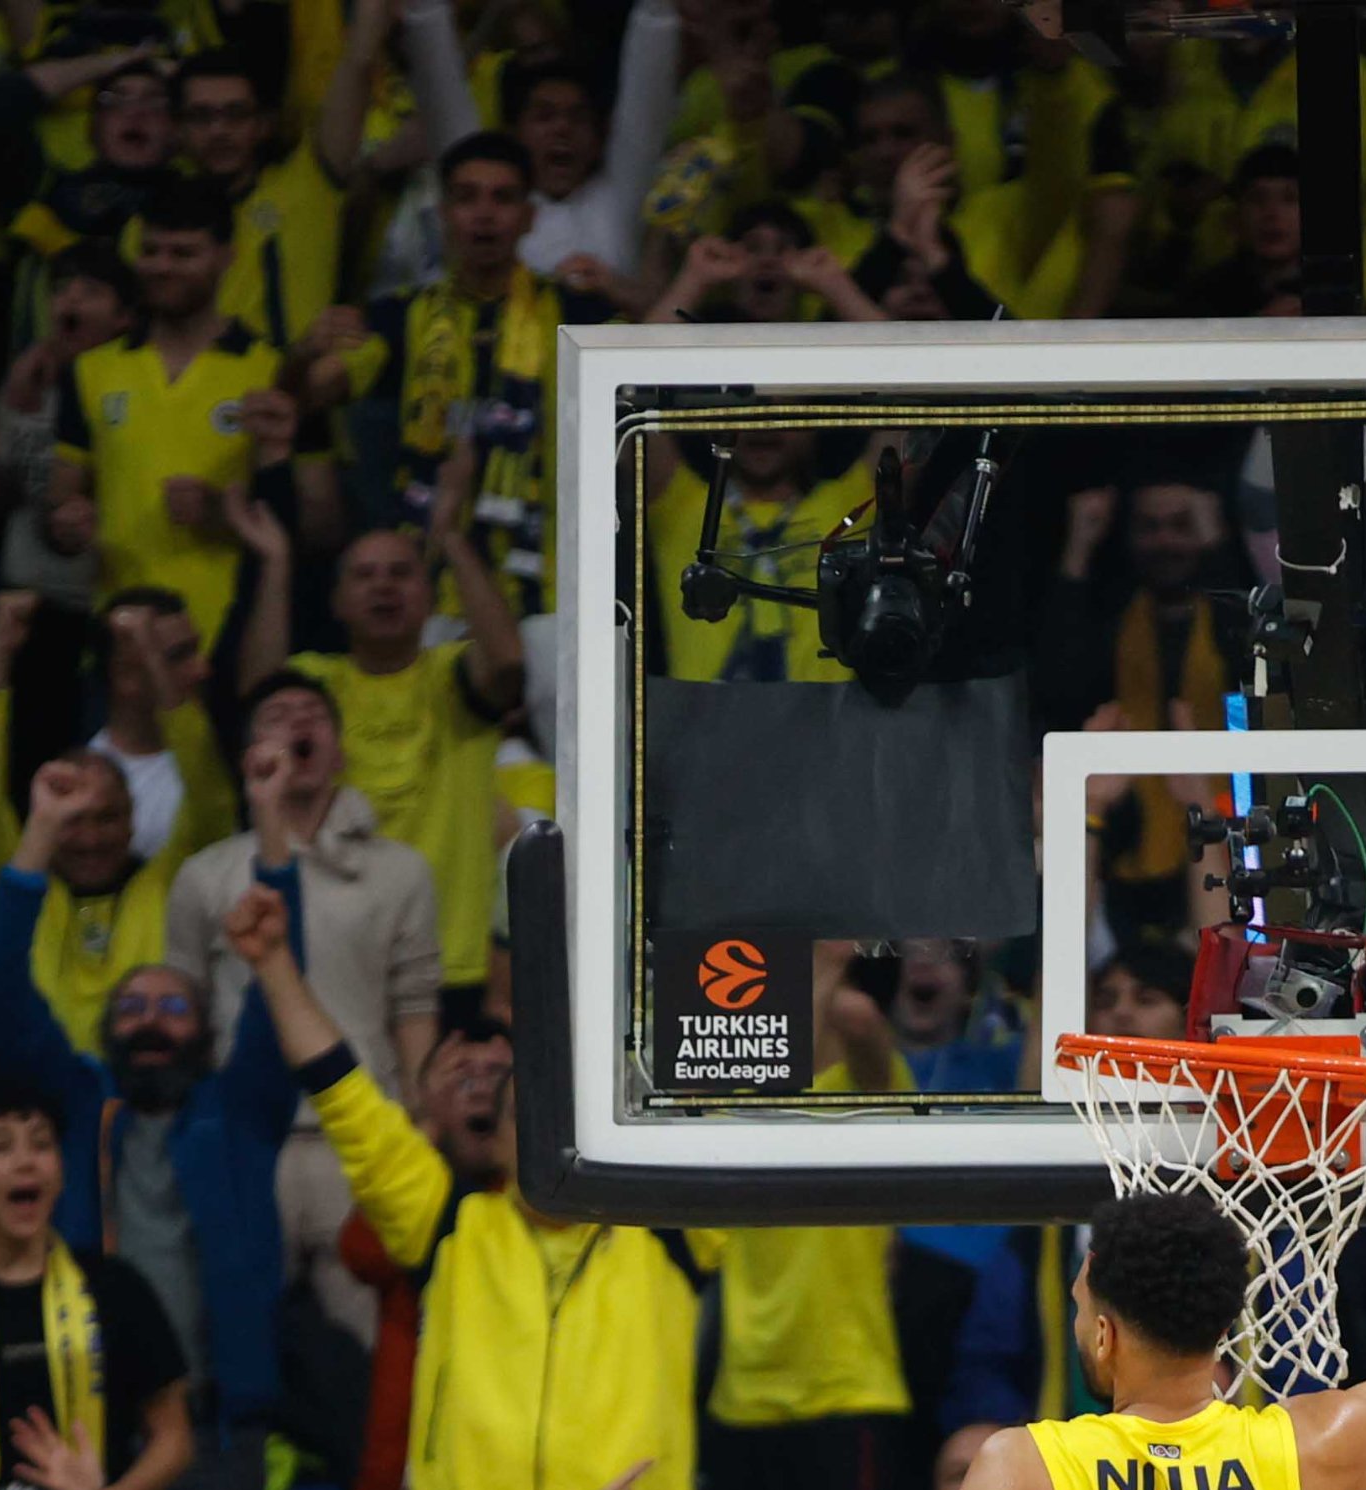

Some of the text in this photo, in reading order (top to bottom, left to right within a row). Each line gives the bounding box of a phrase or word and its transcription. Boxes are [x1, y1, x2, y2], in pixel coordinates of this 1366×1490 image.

[678, 1015, 788, 1036] TURKISH
[677, 1038, 789, 1059] AIRLINES
[674, 1062, 791, 1084] EuroLeague
